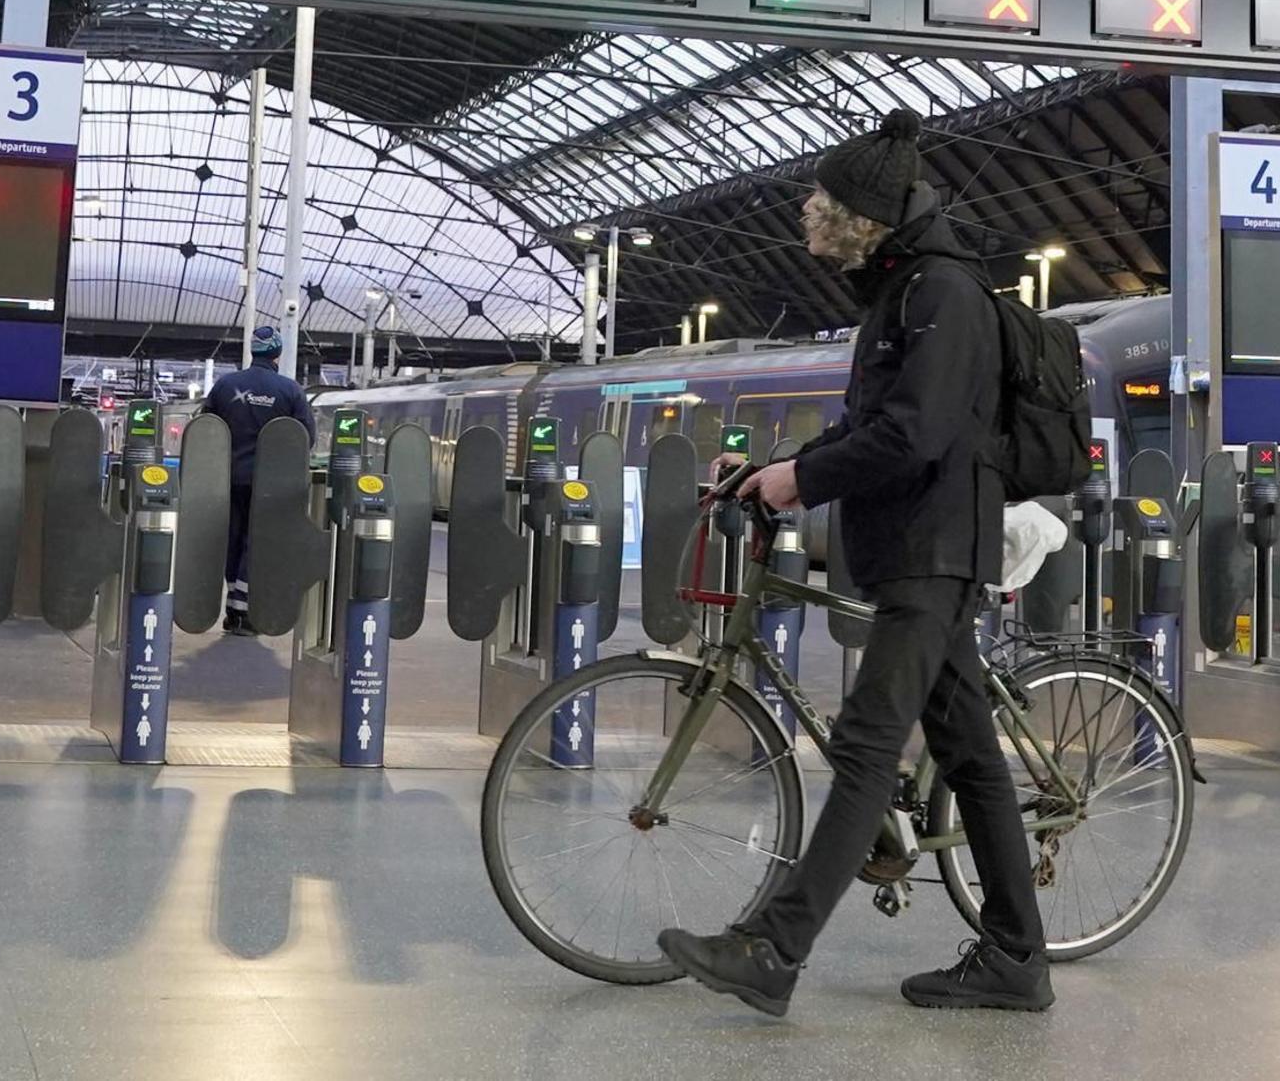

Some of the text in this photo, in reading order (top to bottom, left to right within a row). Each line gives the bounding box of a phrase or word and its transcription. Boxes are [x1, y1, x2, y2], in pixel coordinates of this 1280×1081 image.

[7, 71, 40, 121] 3
[1251, 159, 1277, 204] 4
[1124, 342, 1149, 359] 385
[130, 673, 163, 682] keep your
[132, 682, 161, 690] distance
